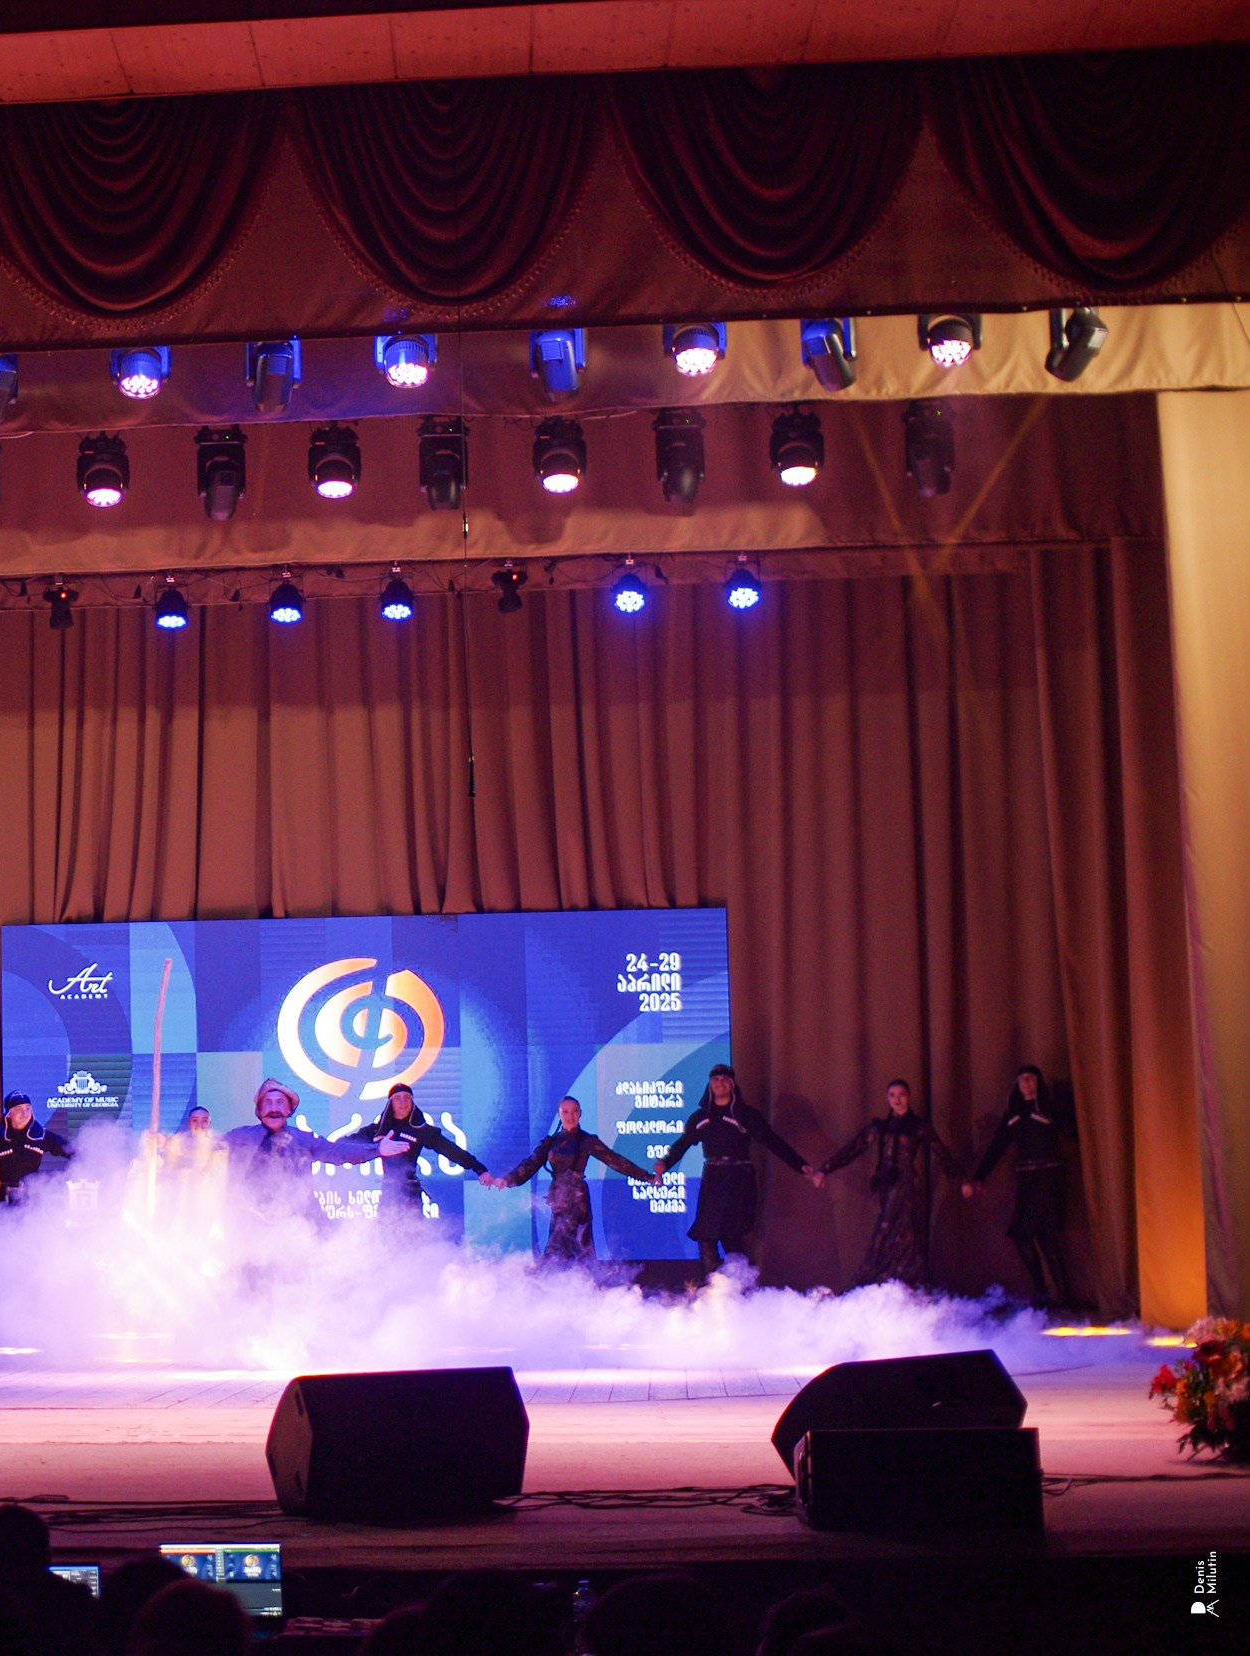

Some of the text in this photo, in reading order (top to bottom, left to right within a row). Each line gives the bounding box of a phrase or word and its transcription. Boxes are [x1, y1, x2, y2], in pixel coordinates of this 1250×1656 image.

[626, 952, 682, 972] 24-29
[49, 963, 113, 994] Art
[617, 972, 682, 992] აპრილი
[639, 992, 682, 1012] 2025
